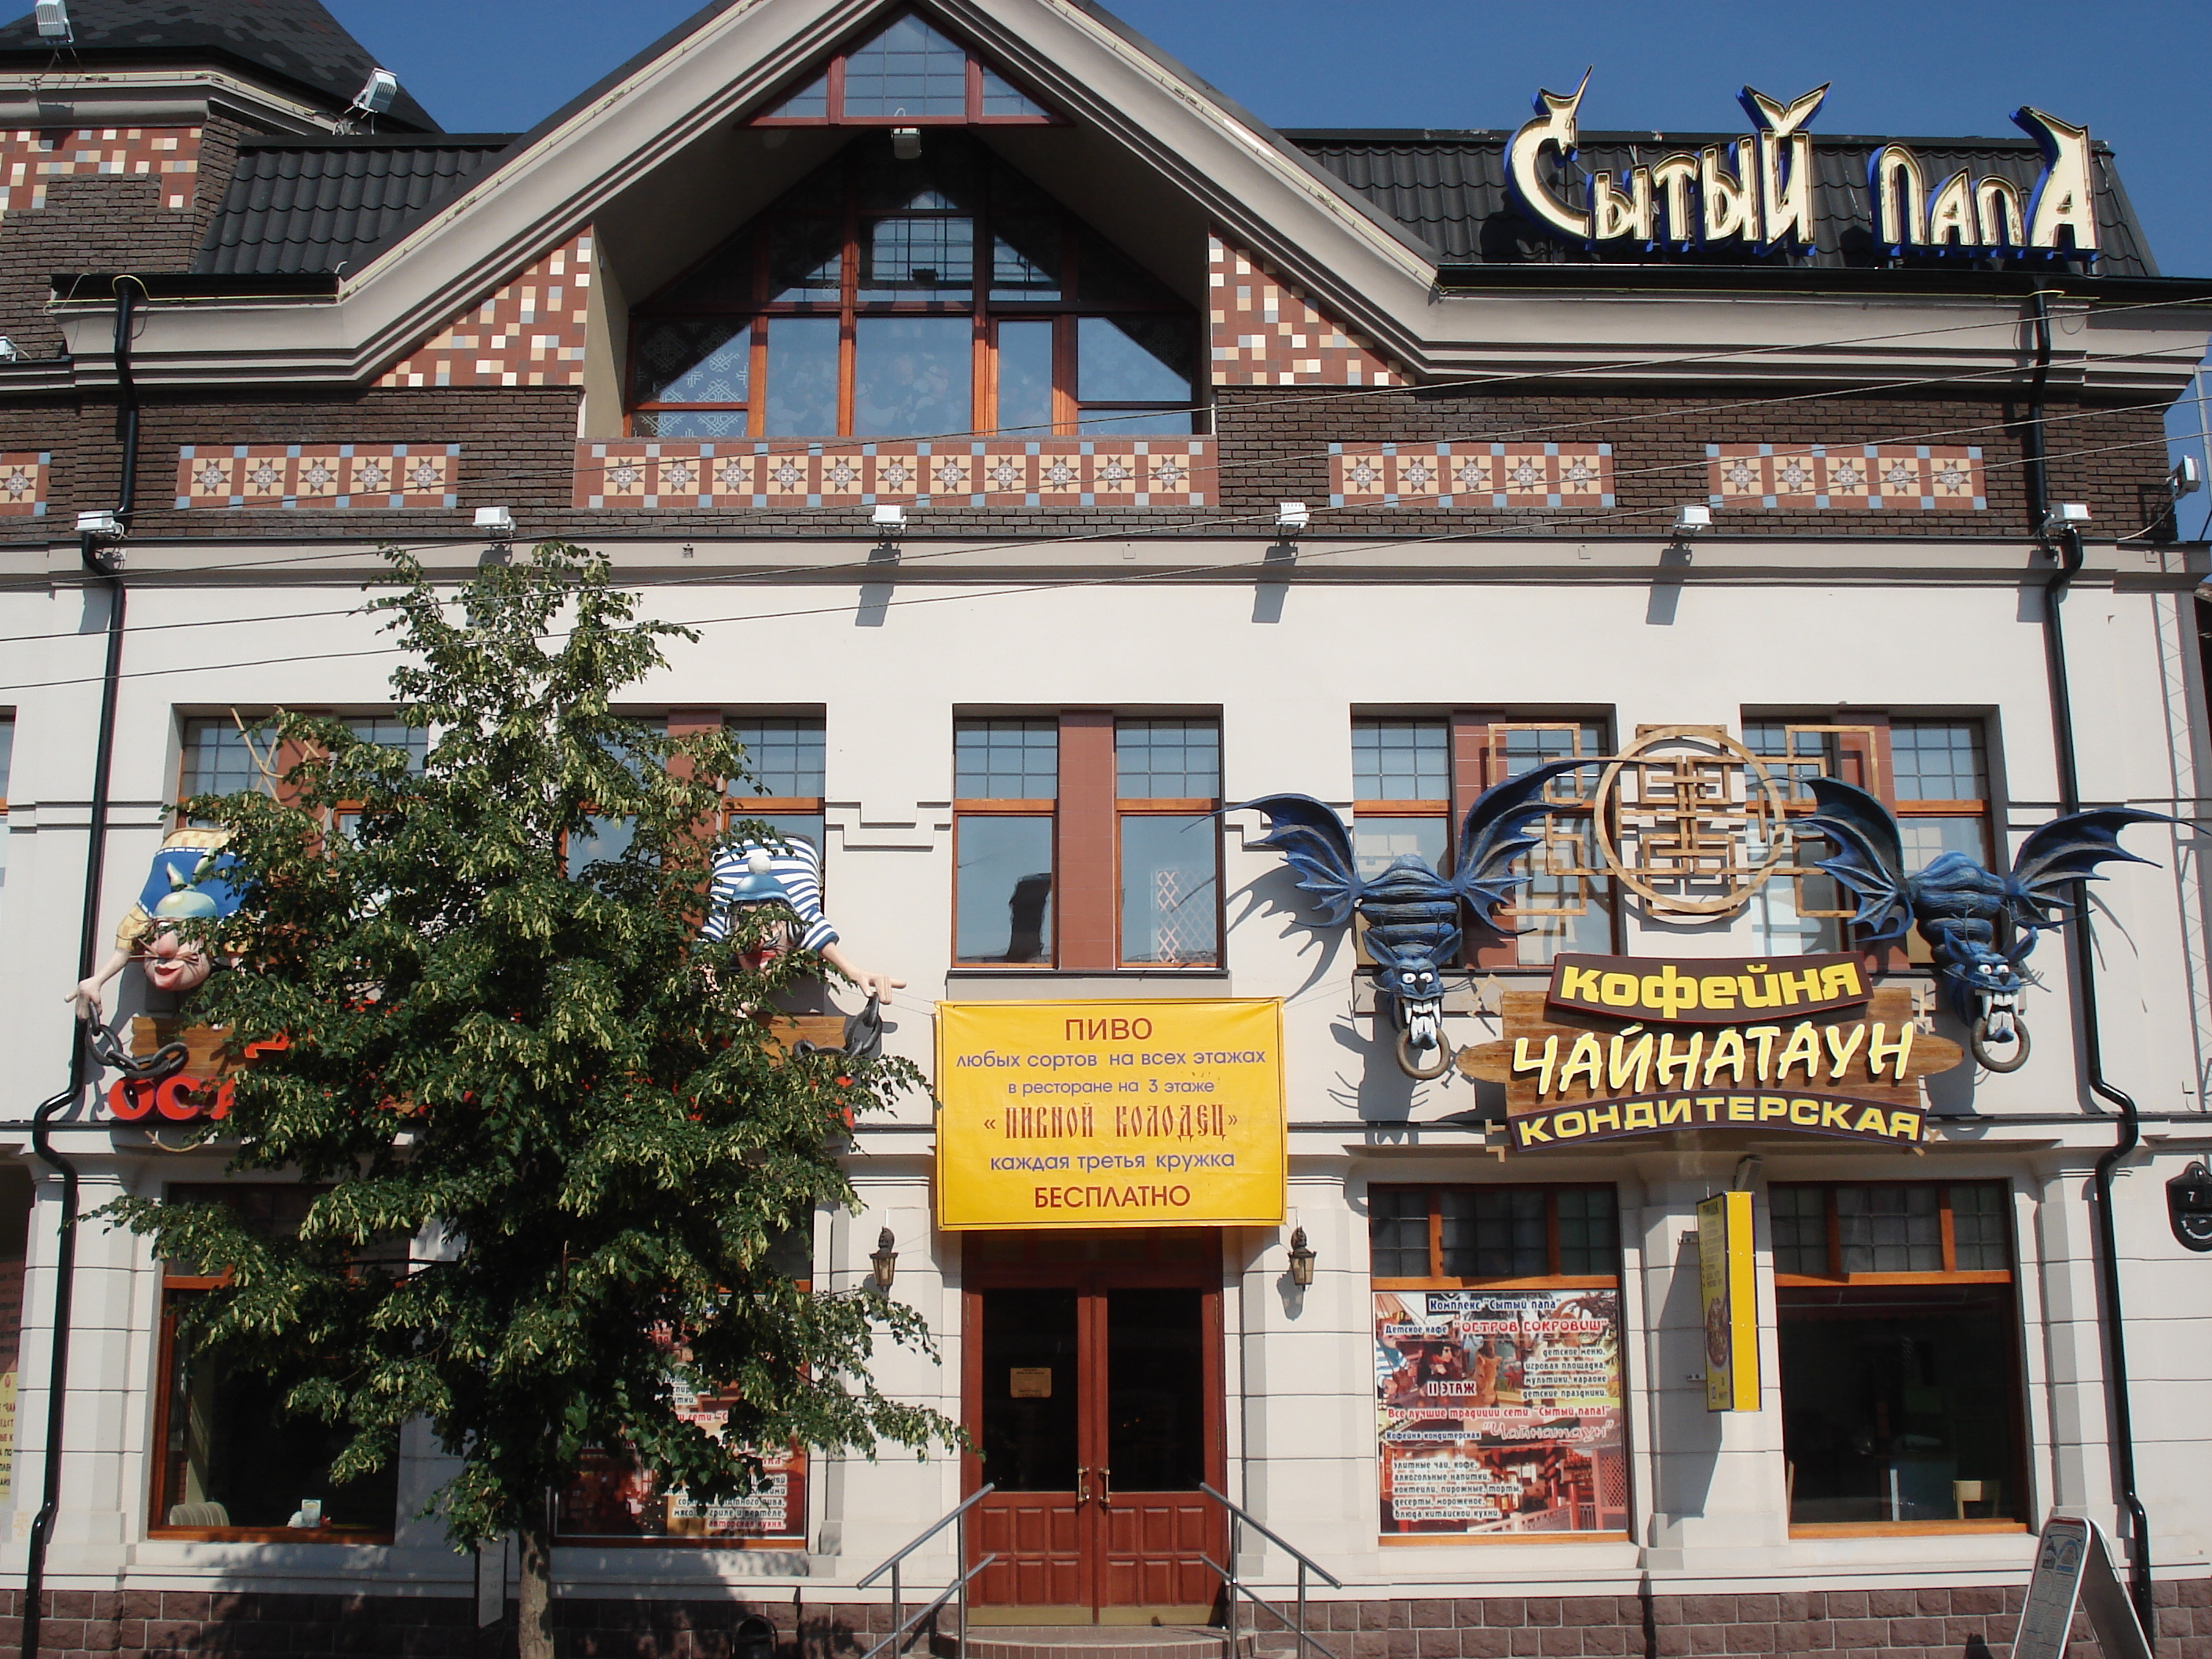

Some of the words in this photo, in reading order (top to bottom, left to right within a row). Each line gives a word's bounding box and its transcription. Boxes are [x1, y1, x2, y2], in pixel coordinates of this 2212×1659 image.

[1065, 1017, 1152, 1041] ПИВО
[957, 1050, 1020, 1068] любых
[1027, 1052, 1097, 1071] сортов
[1109, 1053, 1133, 1066] на
[1141, 1051, 1185, 1065] всех
[1193, 1049, 1265, 1064] этажах
[1513, 1021, 1914, 1095] ЧАЙНАТАУН
[1009, 1082, 1017, 1094] в
[1022, 1081, 1112, 1097] ресторане
[1119, 1081, 1139, 1093] на
[1148, 1079, 1159, 1093] 3
[1164, 1080, 1215, 1093] этаже
[1518, 1096, 1921, 1147] КОНДИТЕРСКАЯ
[991, 1153, 1070, 1172] каждая
[1077, 1153, 1145, 1173] третья
[1156, 1152, 1236, 1172] кружка
[1035, 1185, 1191, 1208] БЕСПЛАТНО
[2188, 1192, 2196, 1202] 7
[1430, 1300, 1481, 1310] Комплекс
[1386, 1325, 1423, 1334] Детское
[1426, 1326, 1447, 1335] кафе
[1442, 1382, 1474, 1394] ЭТАЖ
[1573, 1375, 1606, 1384] караоке
[1388, 1408, 1404, 1418] Все
[1409, 1410, 1446, 1419] лучшие
[1449, 1409, 1500, 1419] традиции
